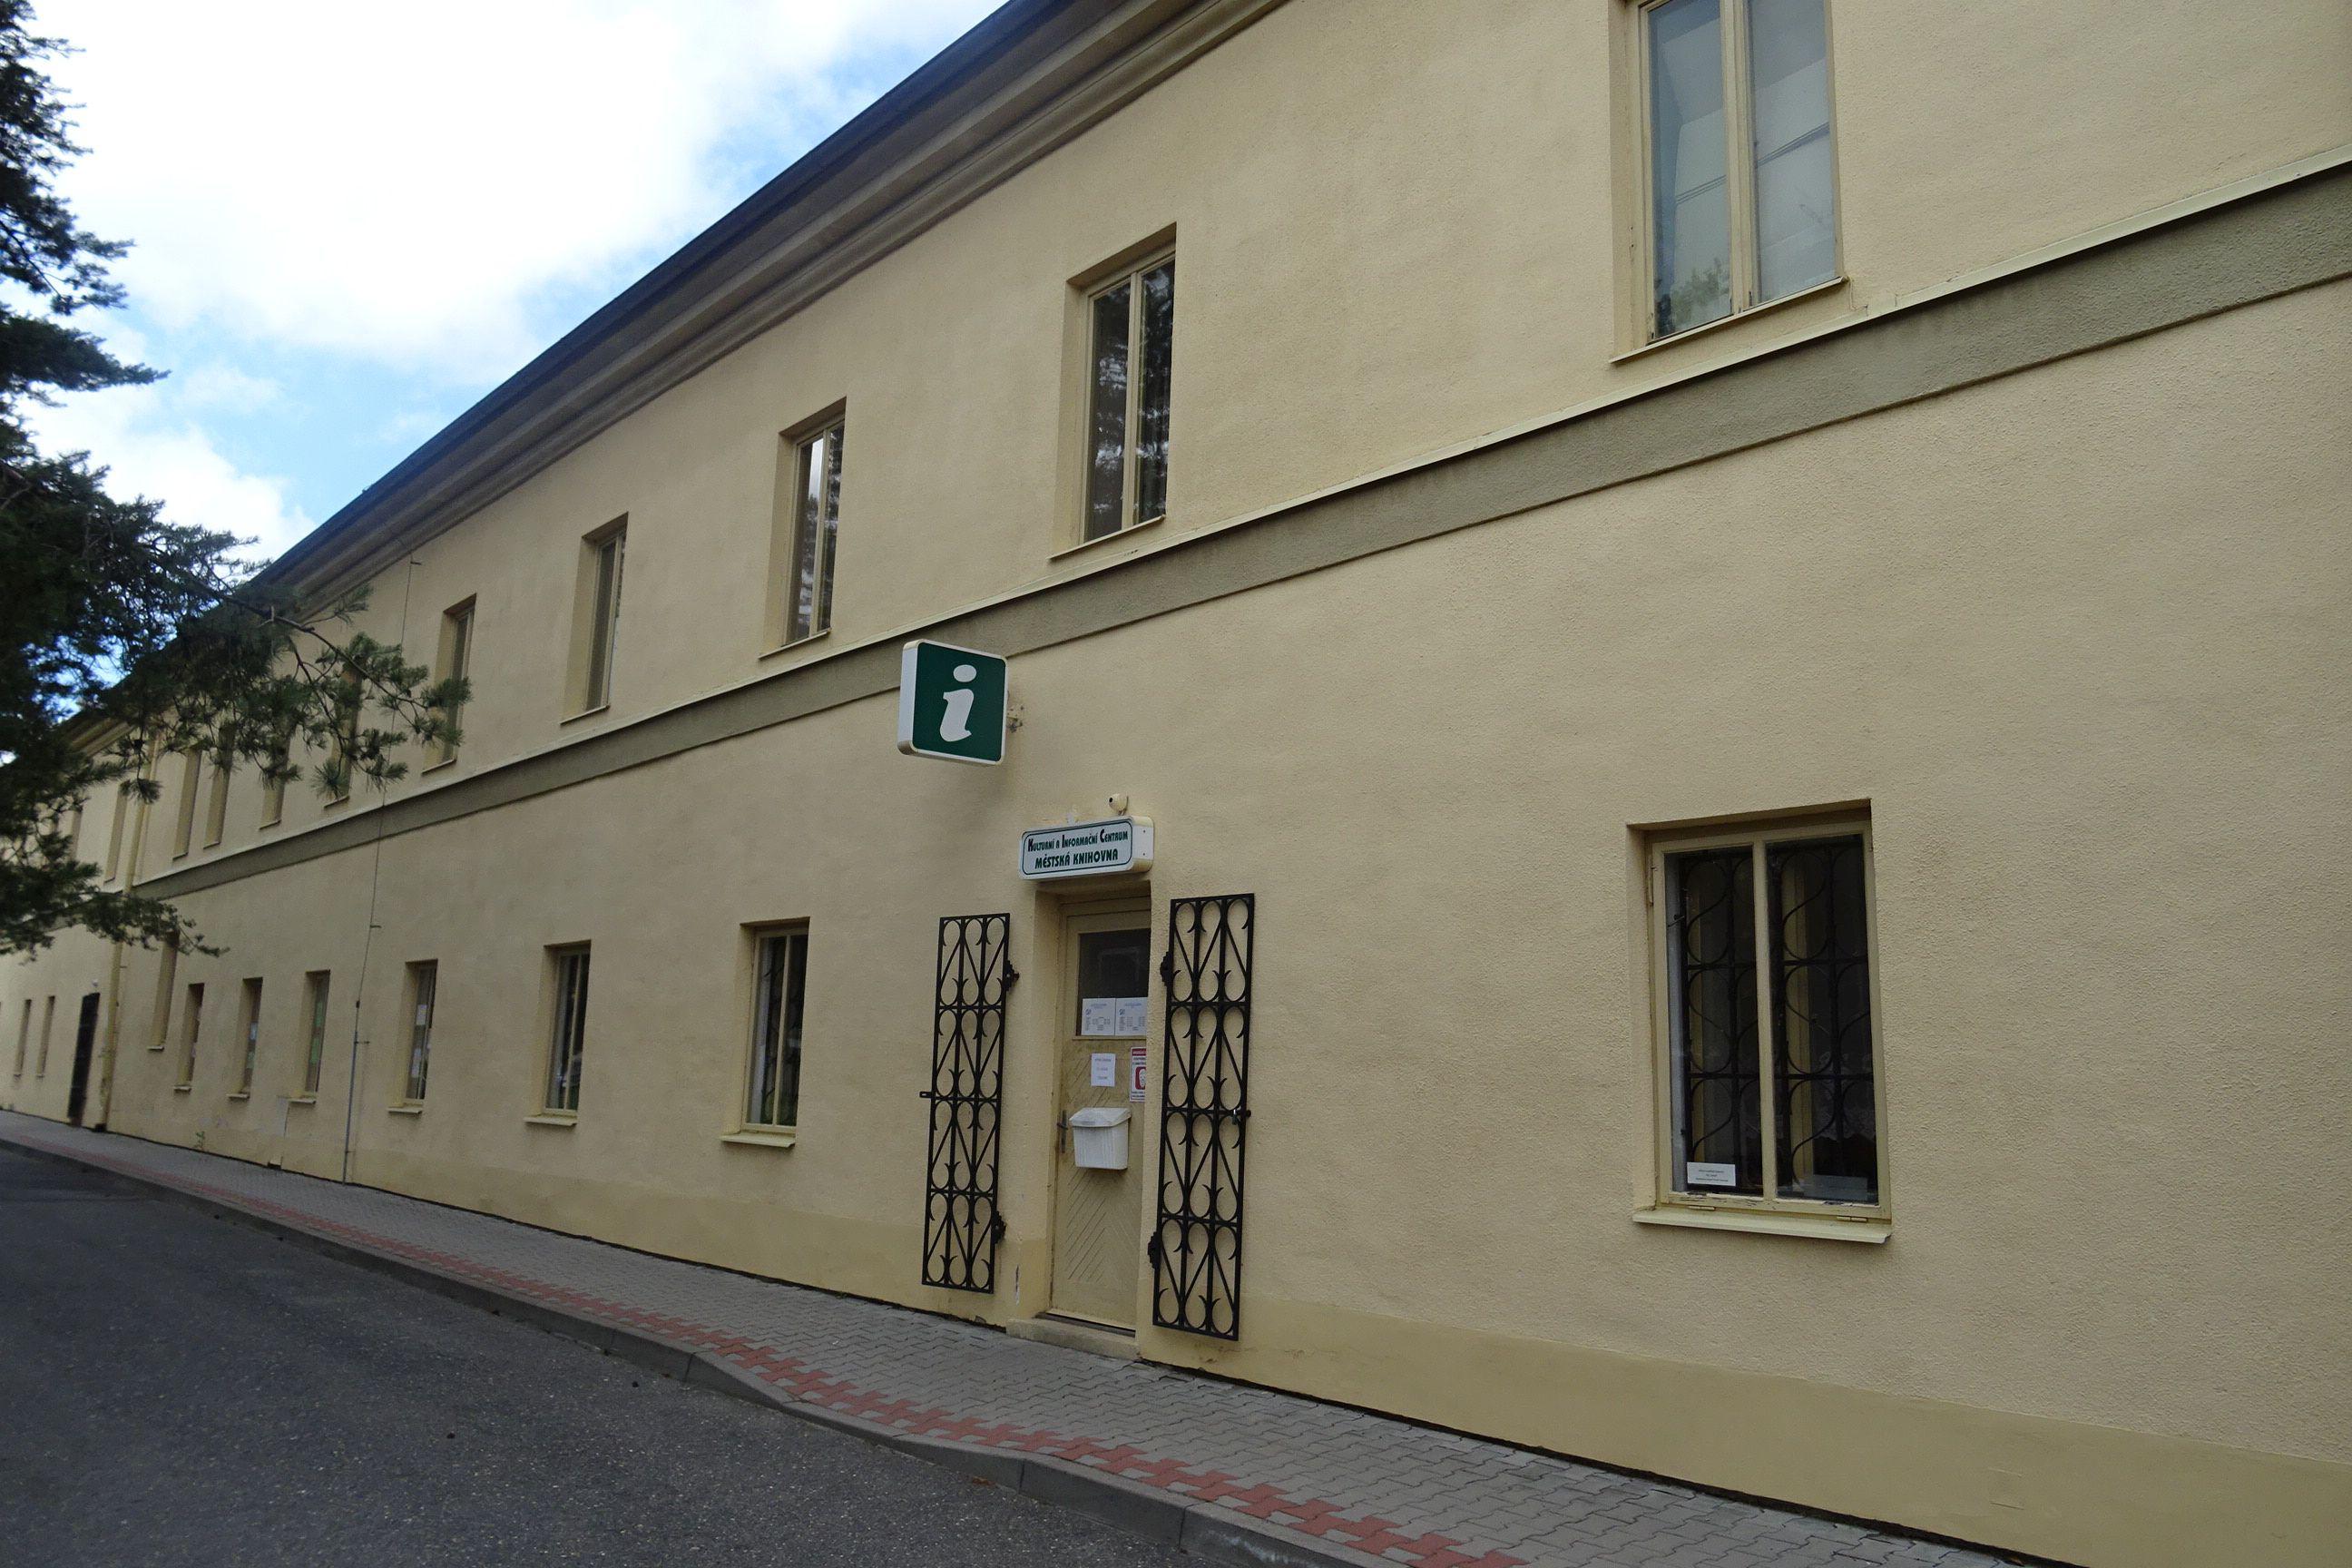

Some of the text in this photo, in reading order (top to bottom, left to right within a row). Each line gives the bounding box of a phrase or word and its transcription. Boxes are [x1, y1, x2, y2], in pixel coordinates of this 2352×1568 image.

[939, 664, 977, 742] i
[1100, 828, 1128, 843] CENTRUM
[1034, 848, 1118, 869] MĚSTSKÁ KNIHOVNA
